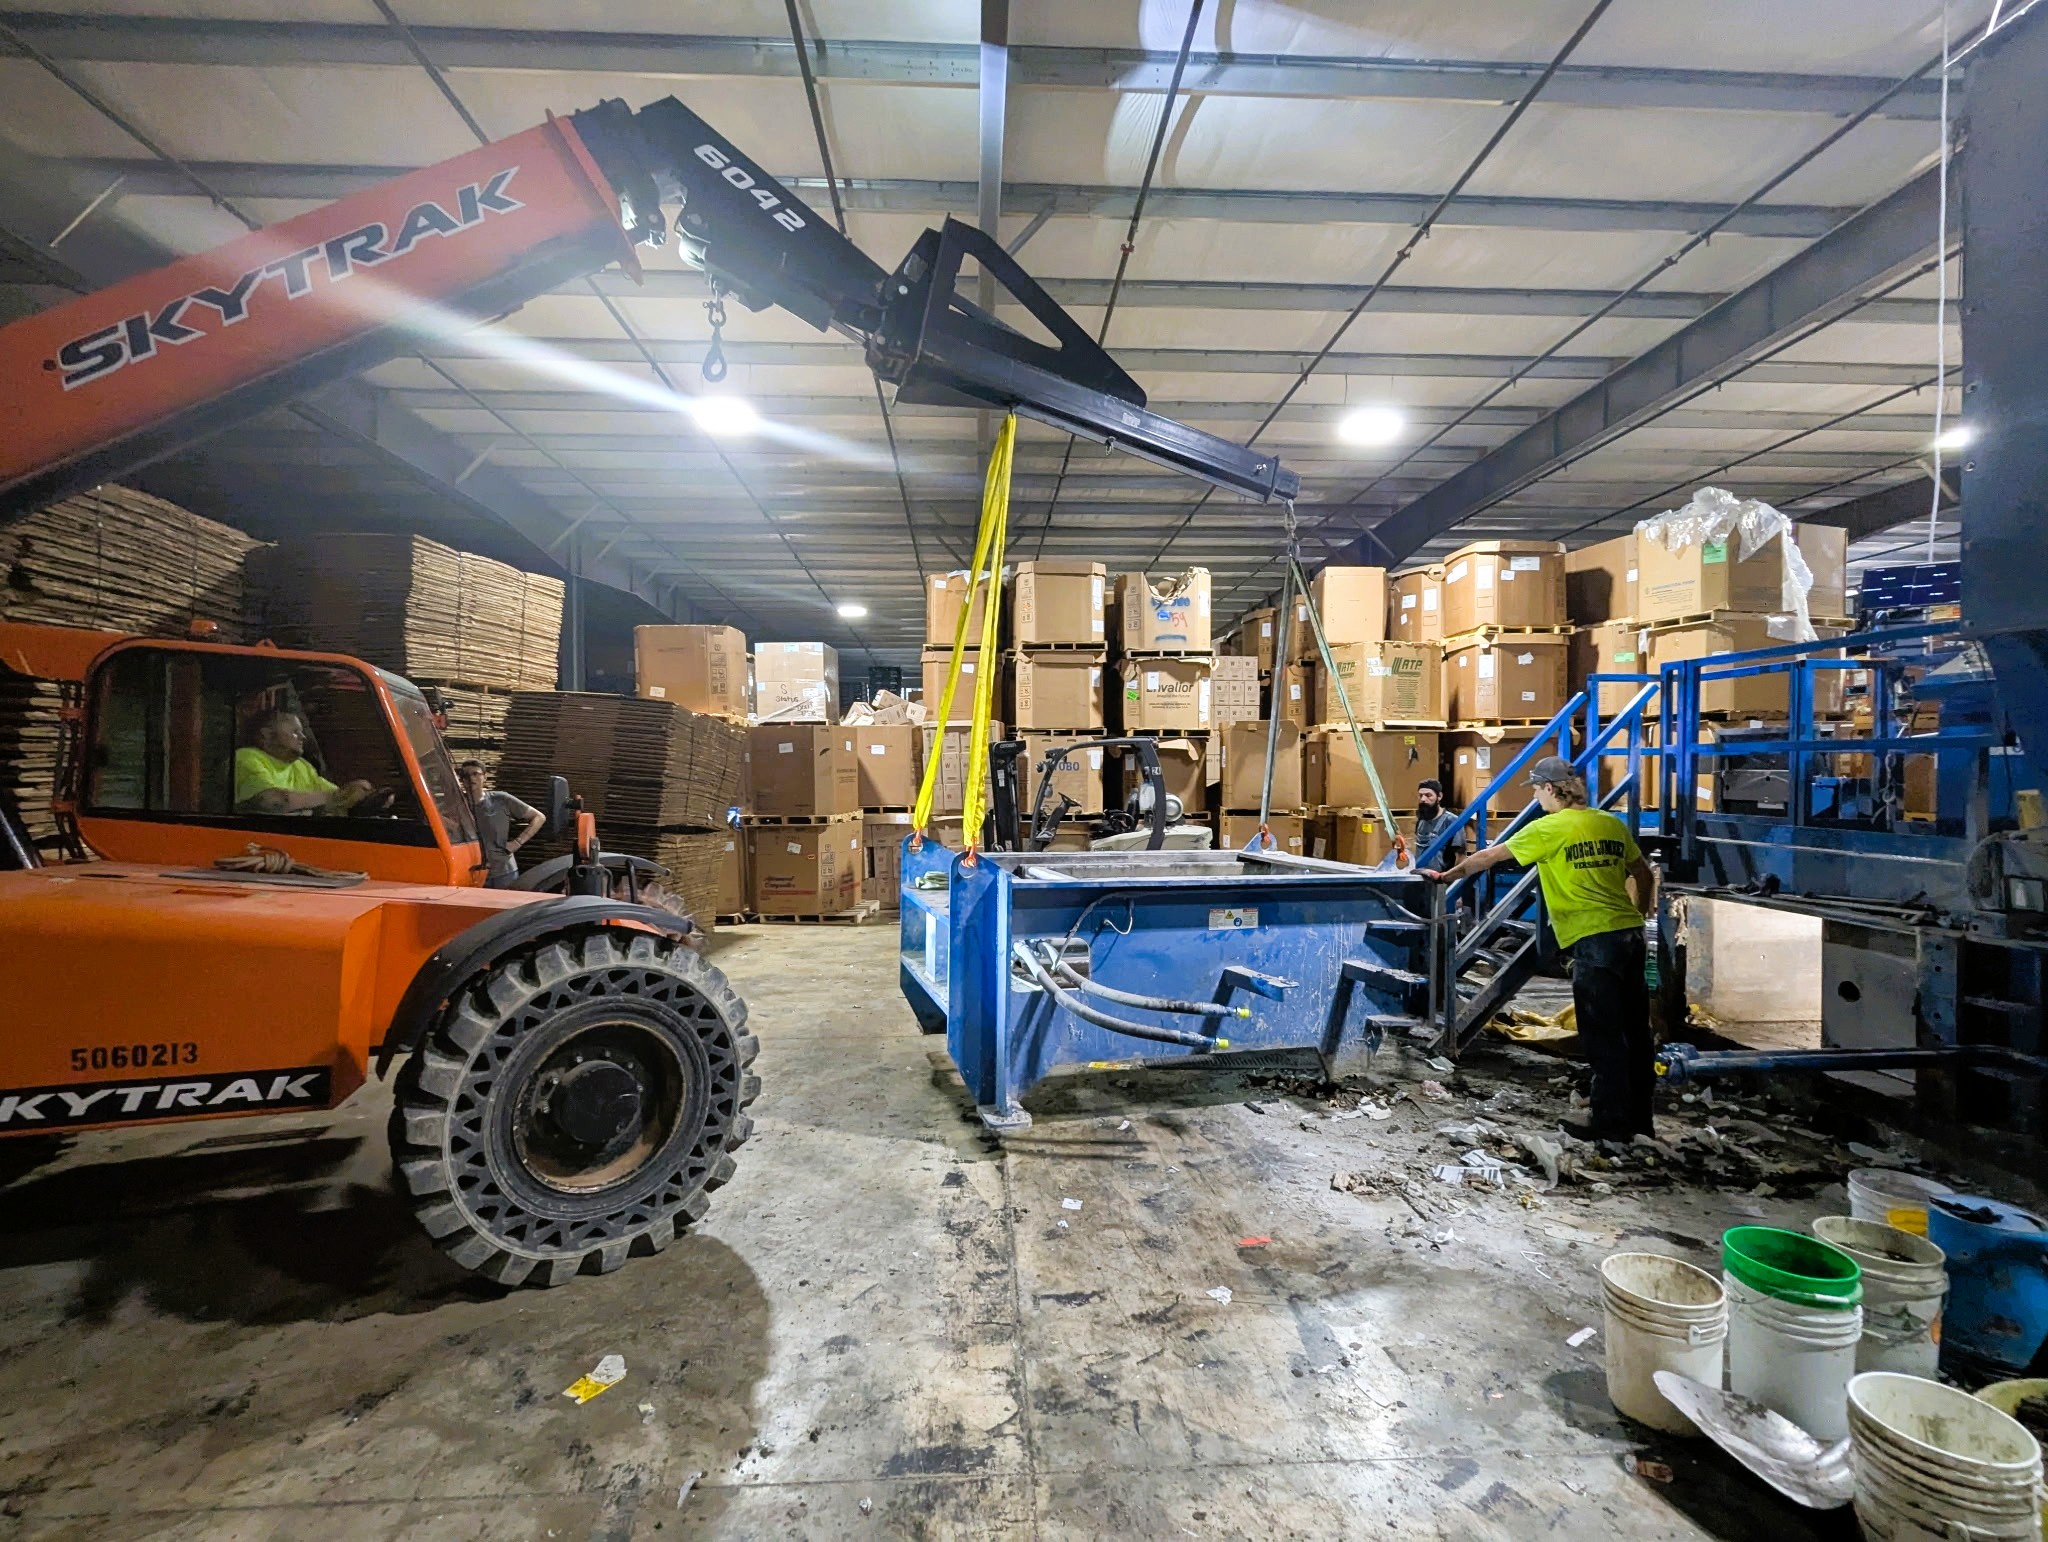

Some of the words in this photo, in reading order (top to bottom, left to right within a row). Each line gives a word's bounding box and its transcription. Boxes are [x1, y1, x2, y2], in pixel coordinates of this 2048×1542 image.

[694, 144, 806, 232] 6042
[56, 166, 526, 391] SKYTRAK
[71, 1042, 199, 1072] 5060213
